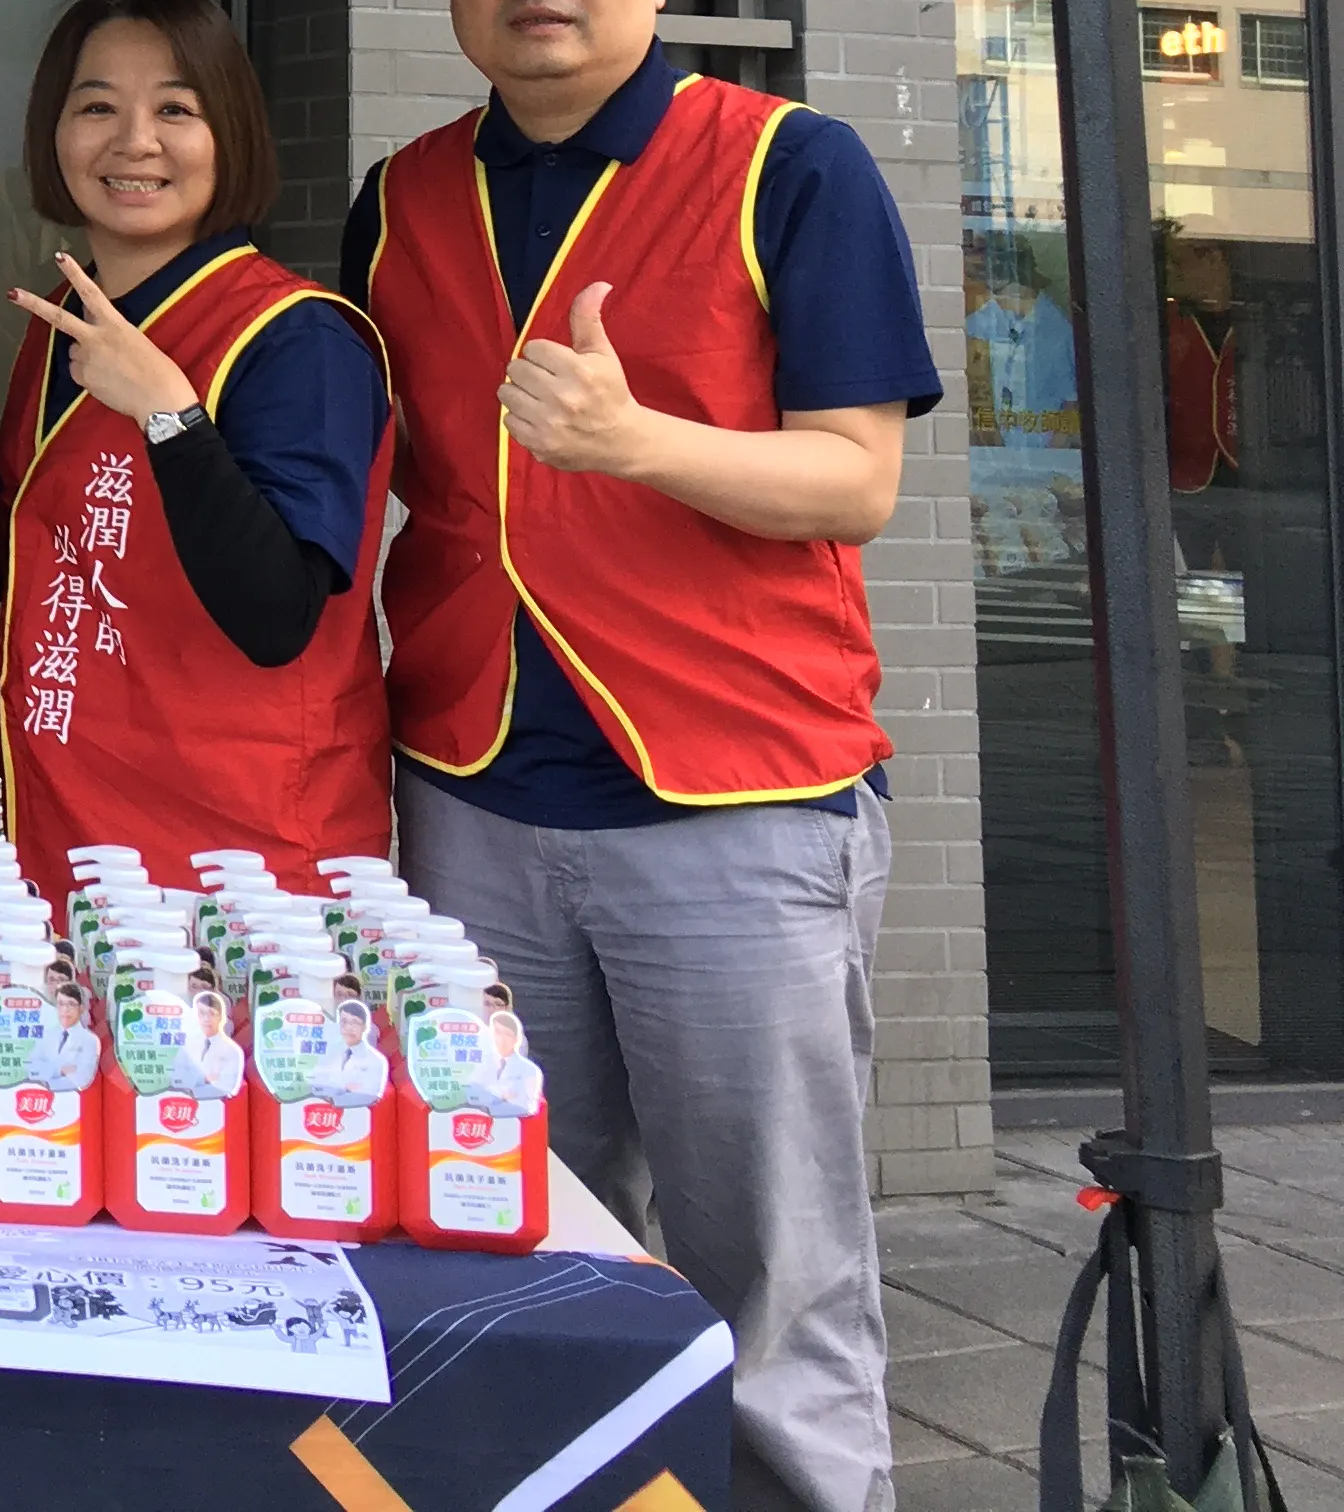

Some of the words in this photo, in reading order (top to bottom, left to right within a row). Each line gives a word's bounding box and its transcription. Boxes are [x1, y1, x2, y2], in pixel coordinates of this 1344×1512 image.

[80, 451, 135, 667] 滋潤人的
[22, 523, 93, 746] 必得滋潤
[13, 1010, 41, 1023] 防疫
[155, 1017, 182, 1031] 防疫
[17, 1024, 44, 1039] 首選
[159, 1032, 186, 1046] 首選
[296, 1025, 323, 1039] 防疫
[300, 1040, 328, 1055] 首選
[450, 1034, 479, 1048] 防疫
[455, 1049, 482, 1063] 首選
[17, 1096, 50, 1112] 美琪
[162, 1105, 192, 1121] 美琪
[306, 1112, 337, 1128] 美琪
[454, 1121, 488, 1137] 美琪
